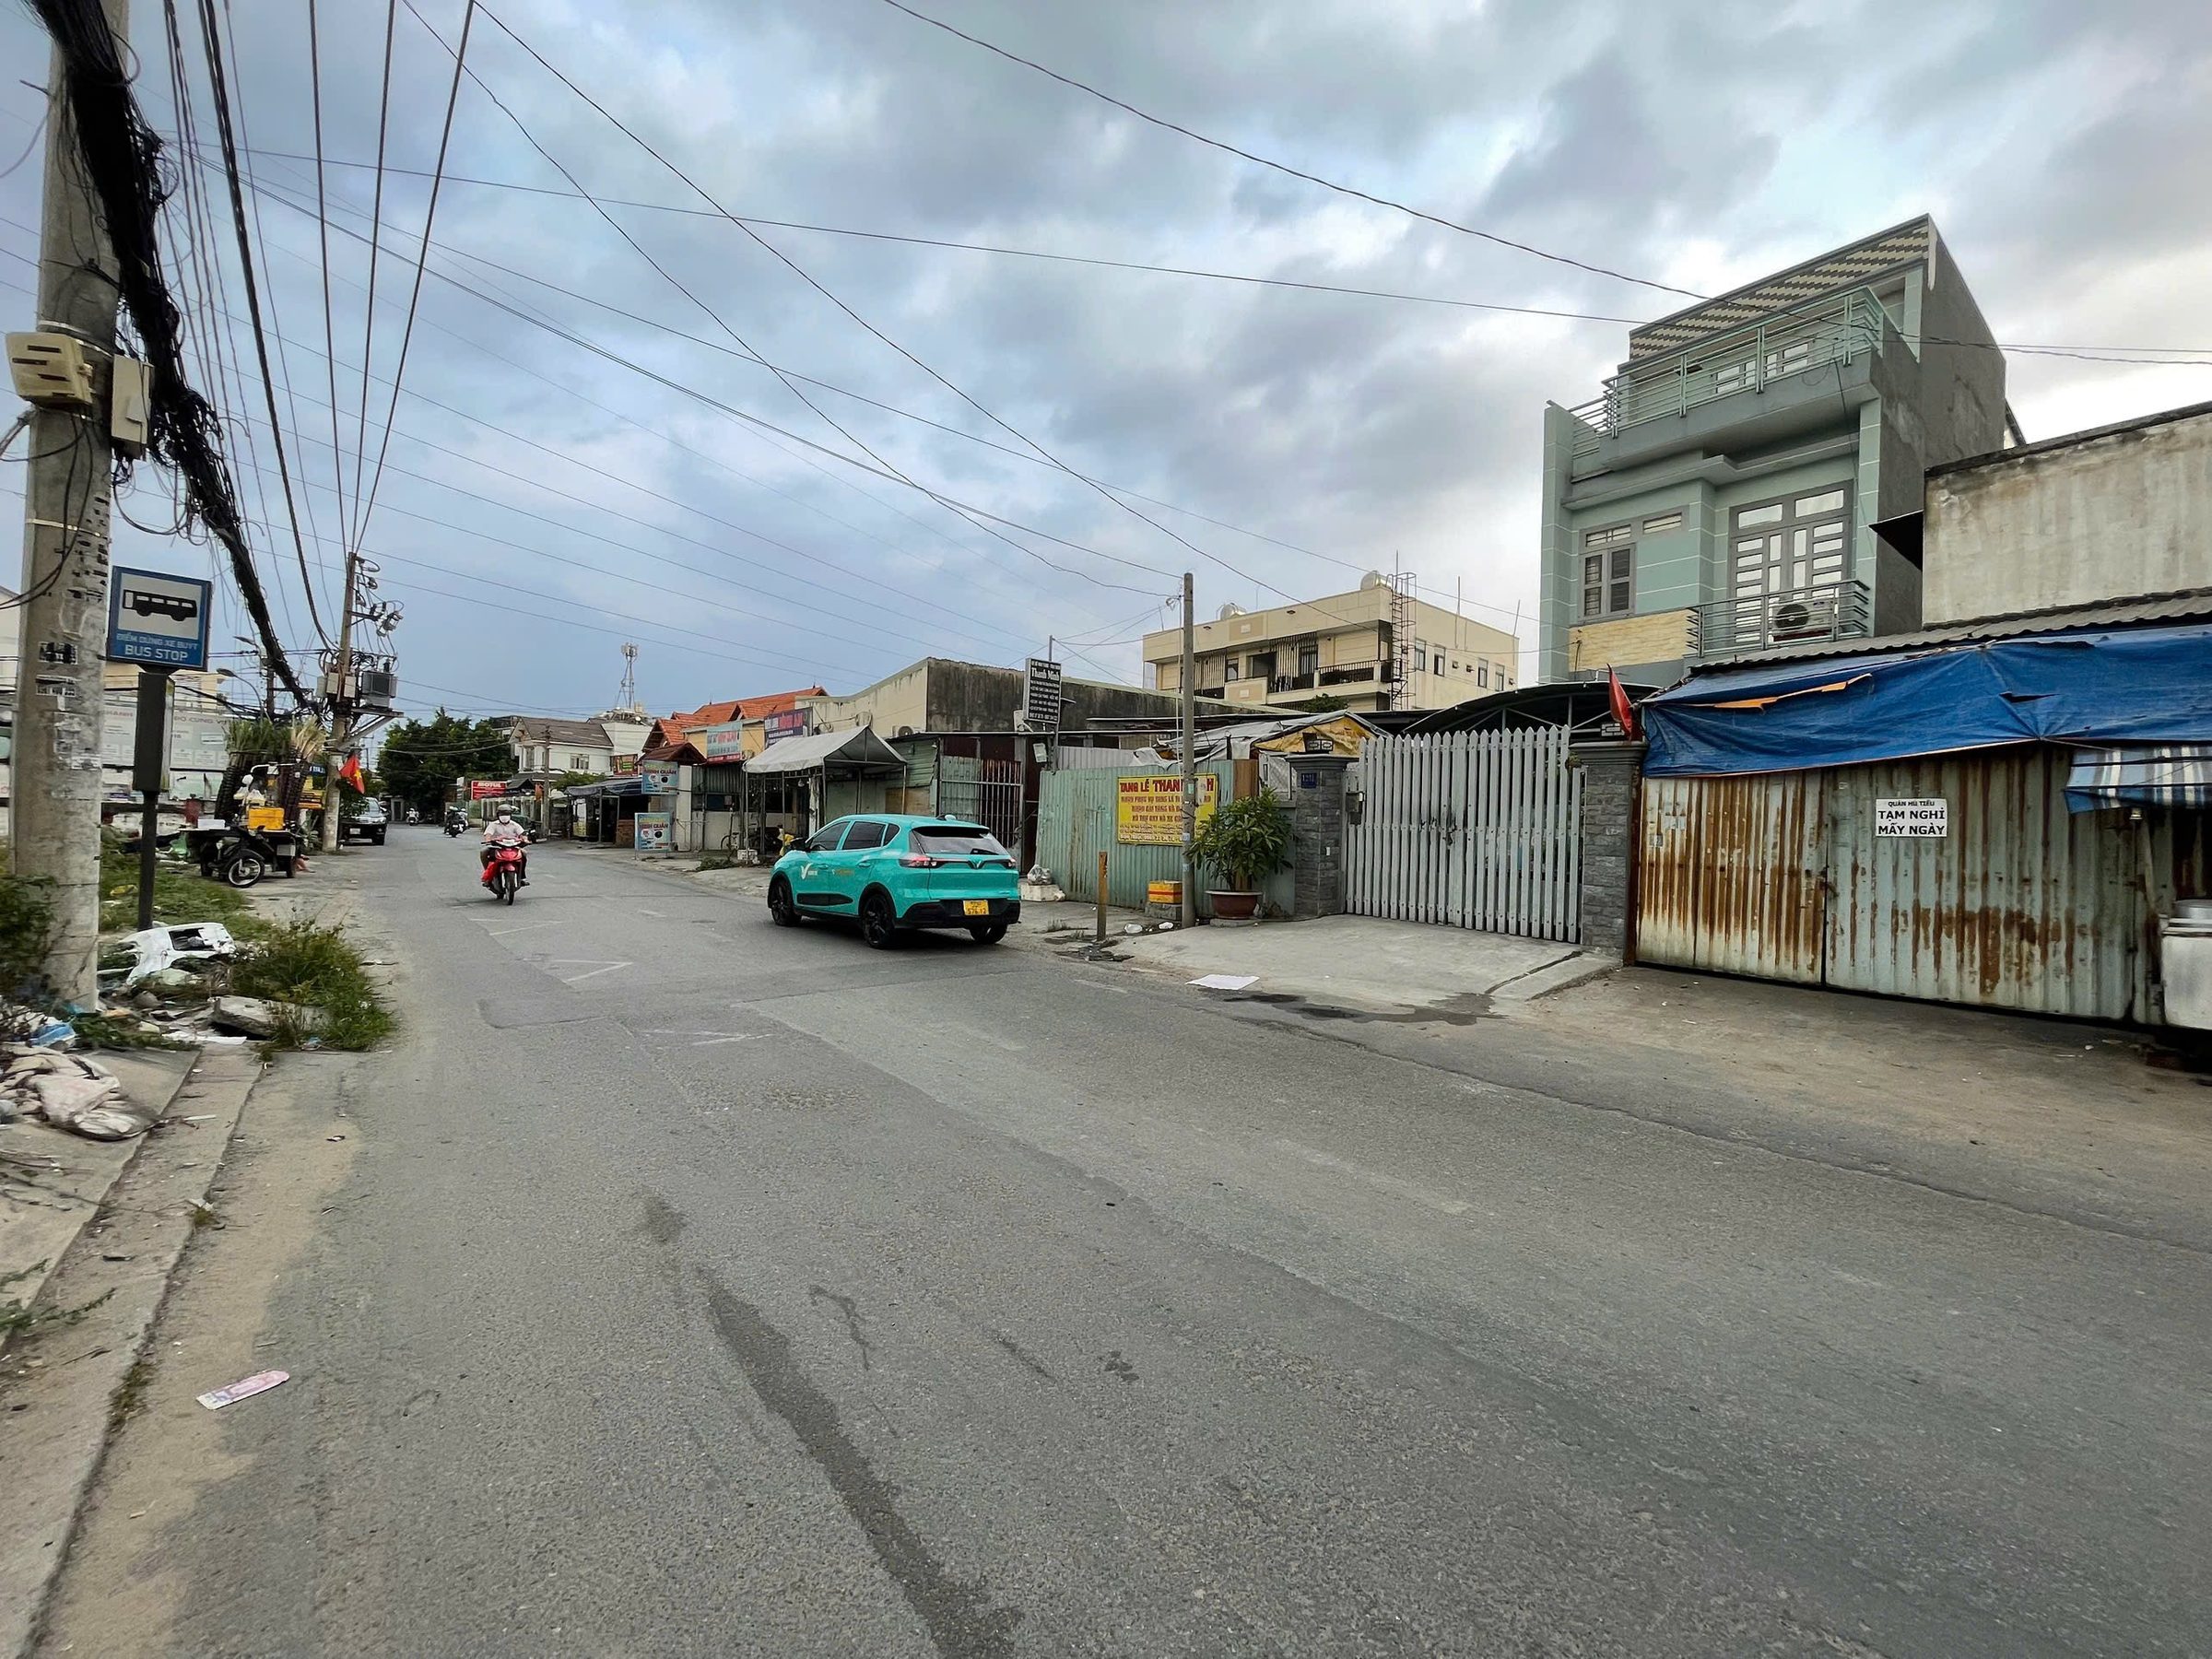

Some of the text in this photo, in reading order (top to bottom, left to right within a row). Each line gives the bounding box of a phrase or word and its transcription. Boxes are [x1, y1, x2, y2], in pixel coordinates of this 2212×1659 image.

[124, 644, 188, 661] BUS STOP
[1877, 806, 1945, 822] TẠM NGHỈ
[1877, 822, 1945, 835] MẤY NGÀY
